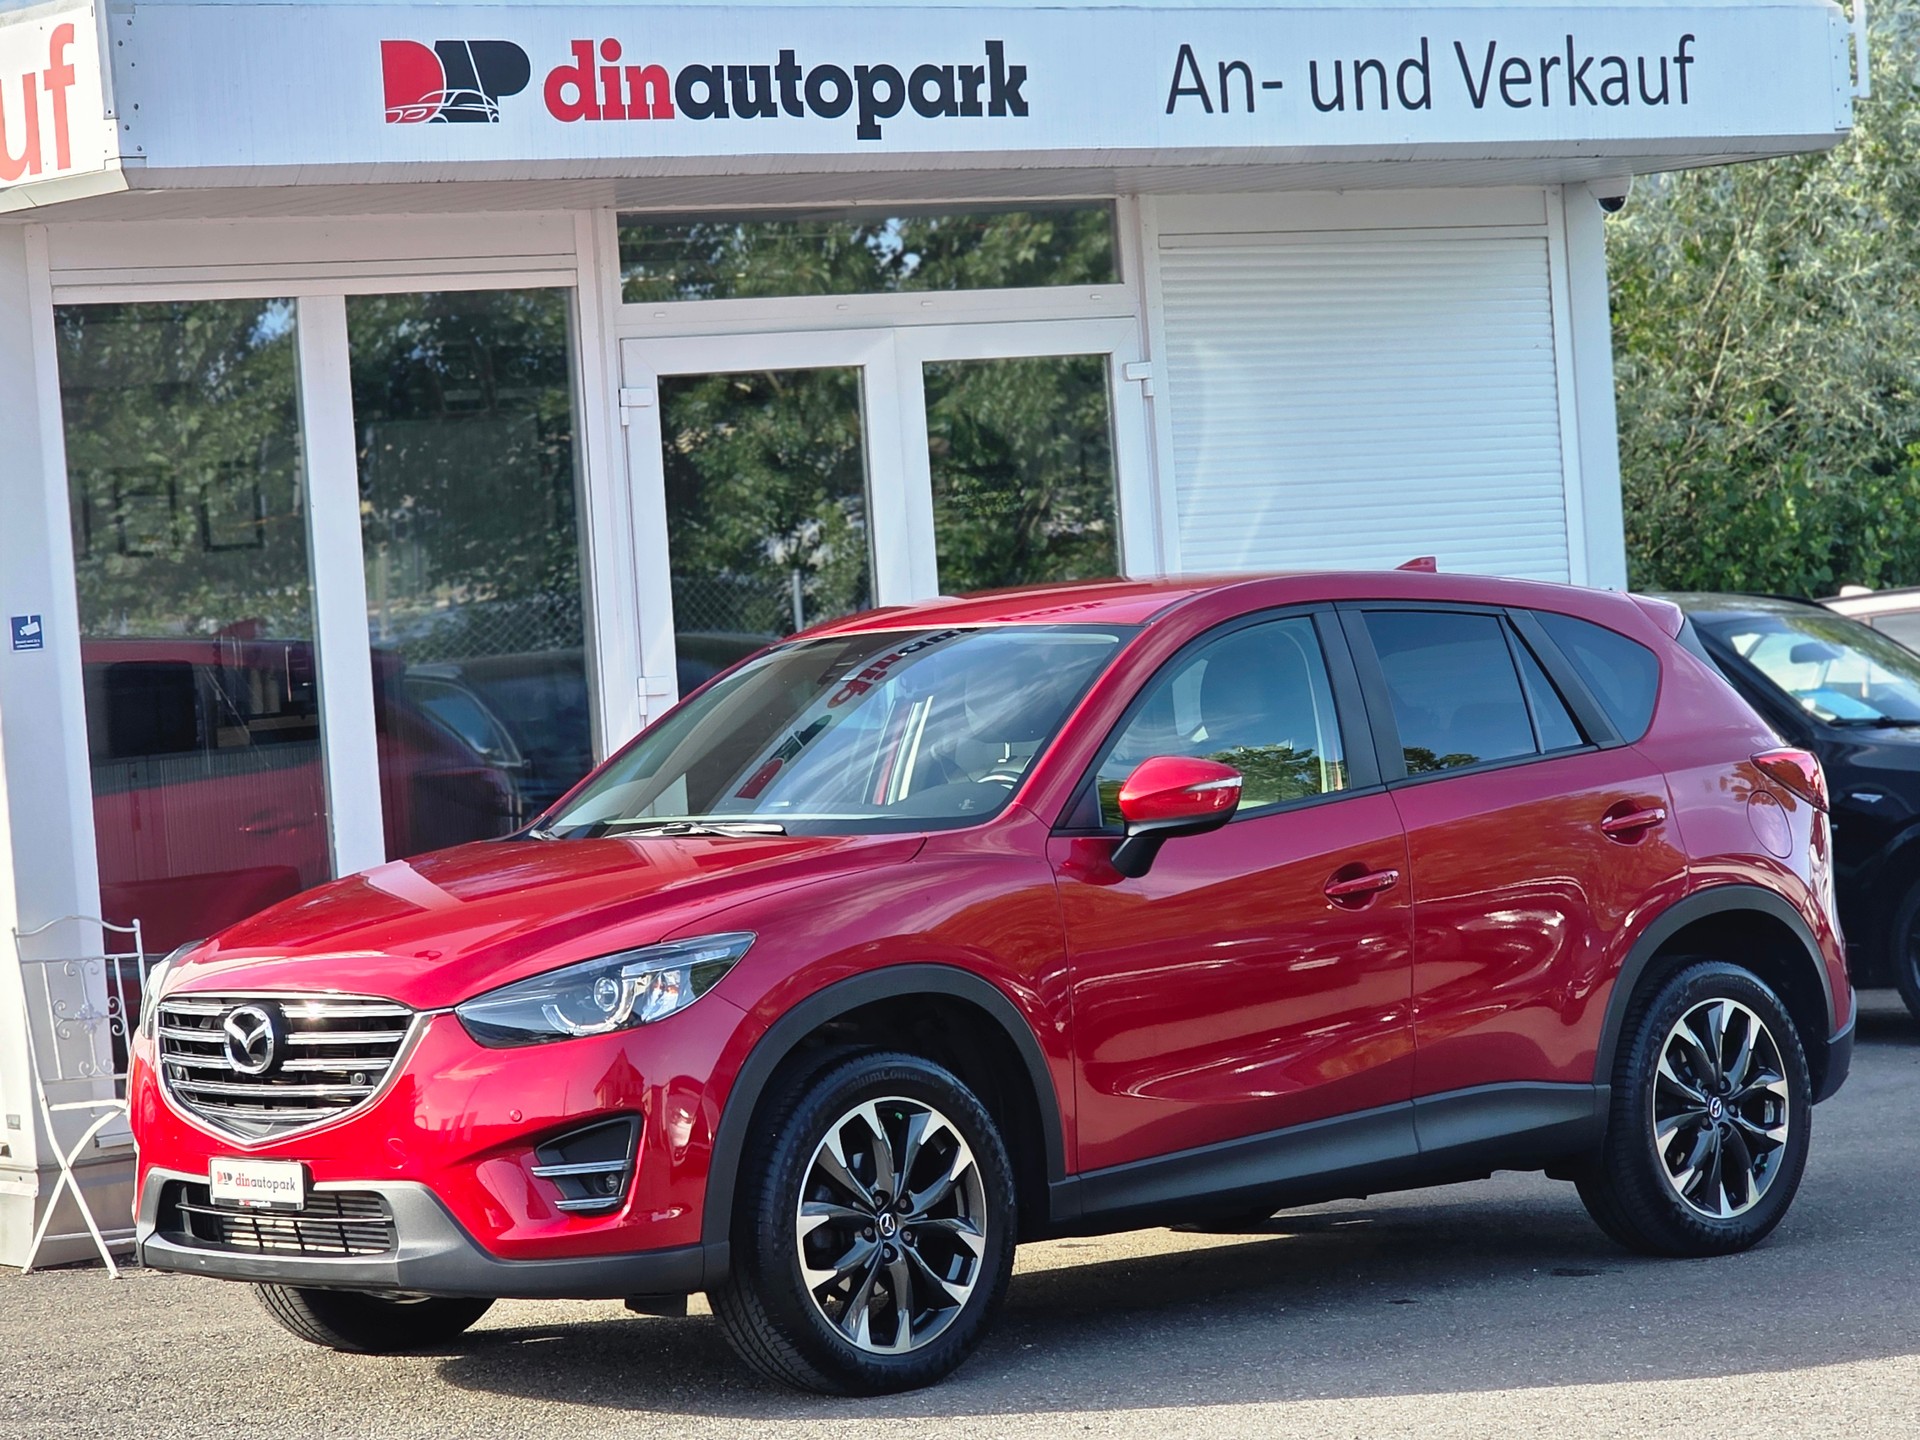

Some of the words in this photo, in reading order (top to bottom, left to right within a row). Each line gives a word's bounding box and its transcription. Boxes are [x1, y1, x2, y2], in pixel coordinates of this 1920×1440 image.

[544, 38, 1030, 141] dinautopark
[1165, 44, 1284, 115] An-
[1309, 37, 1432, 113] und
[1453, 34, 1696, 110] Verkauf
[235, 1173, 296, 1194] dinautopark
